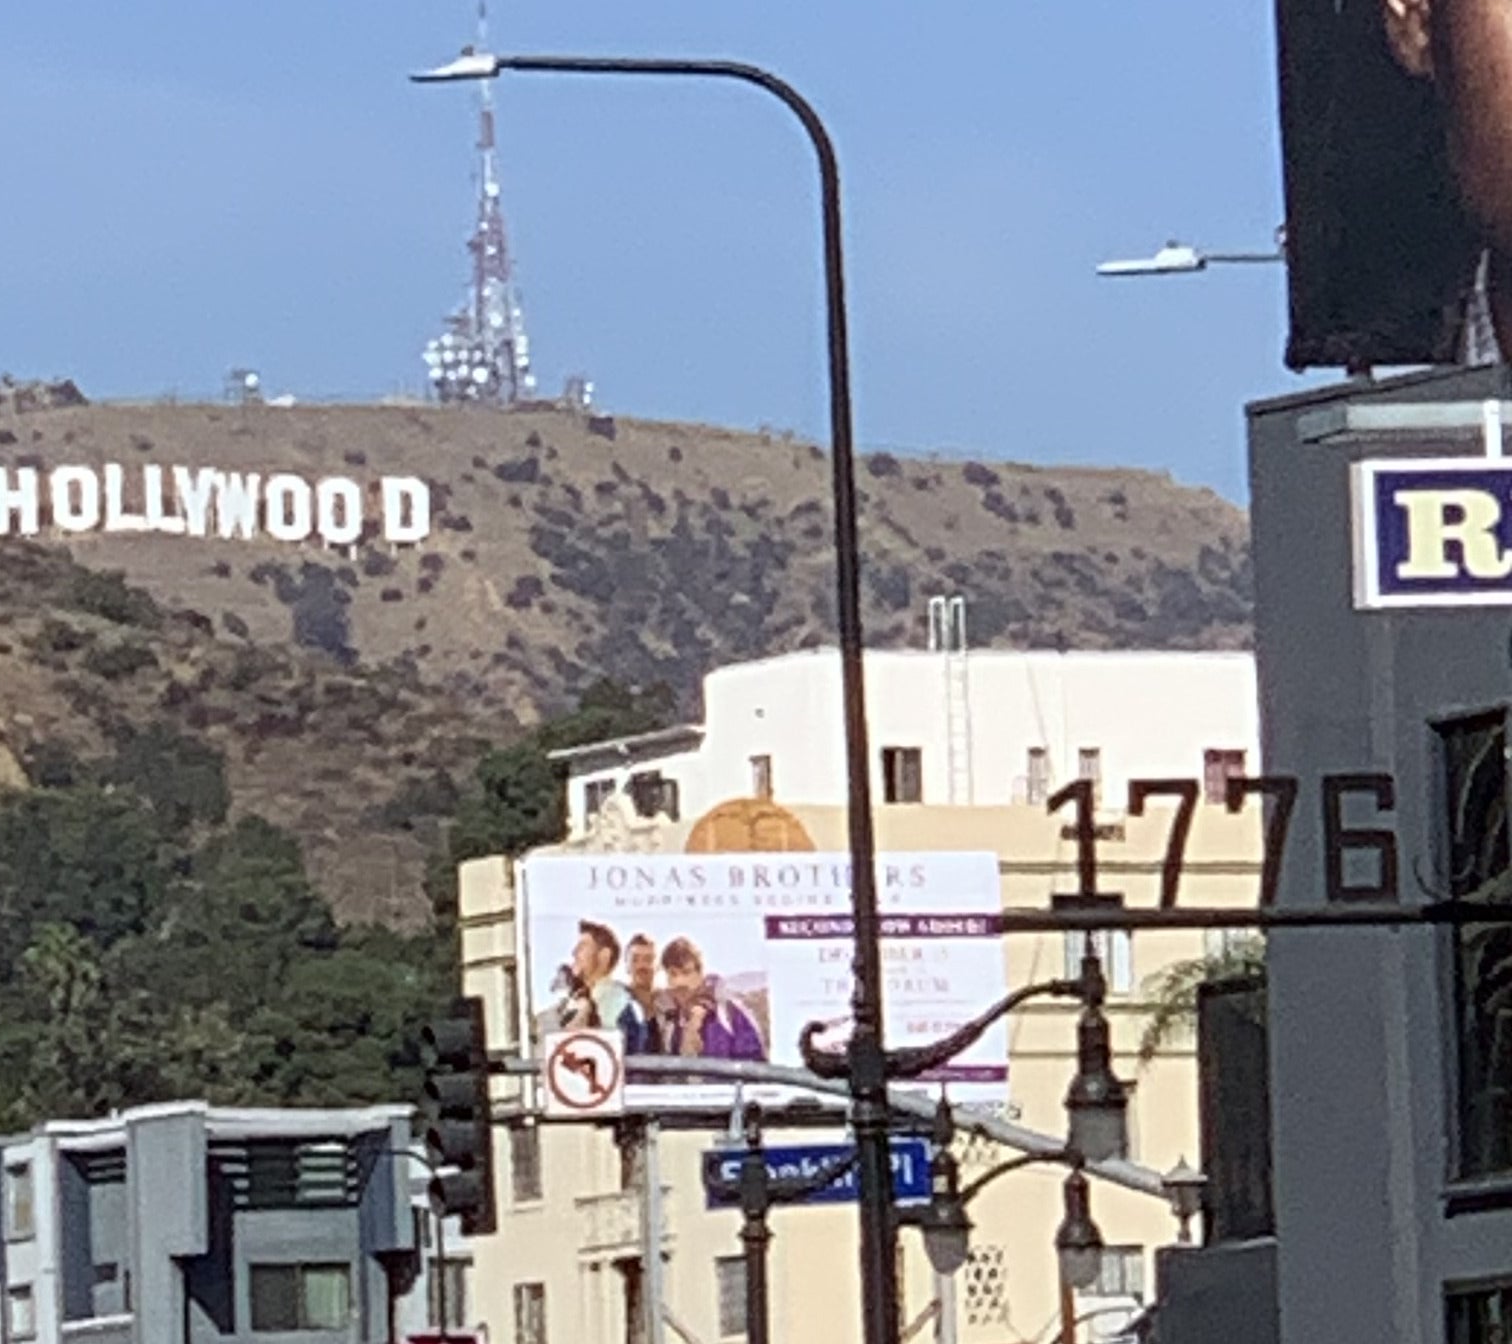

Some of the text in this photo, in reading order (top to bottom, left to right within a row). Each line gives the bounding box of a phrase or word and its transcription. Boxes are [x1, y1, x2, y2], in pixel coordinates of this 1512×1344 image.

[588, 864, 926, 890] JONAS BROTHRS
[1047, 773, 1398, 910] 1776
